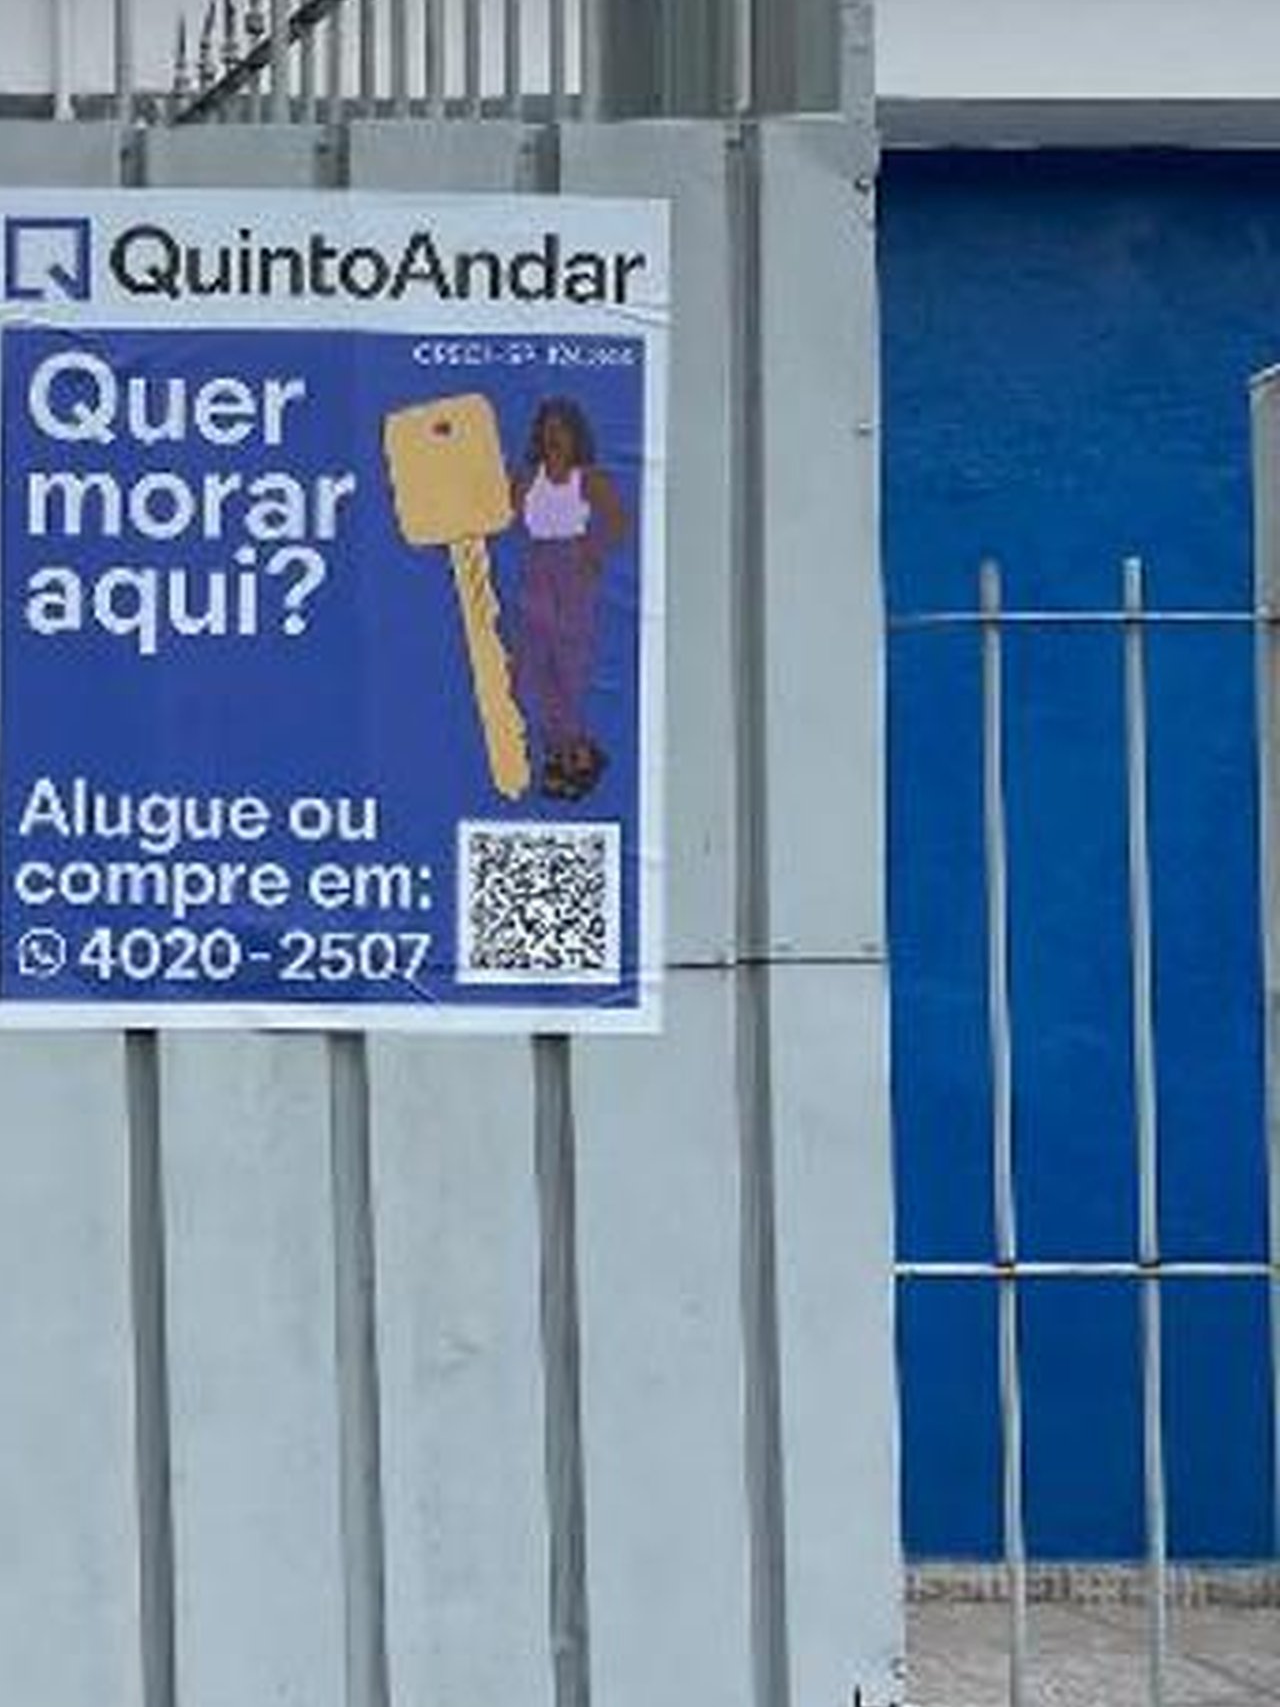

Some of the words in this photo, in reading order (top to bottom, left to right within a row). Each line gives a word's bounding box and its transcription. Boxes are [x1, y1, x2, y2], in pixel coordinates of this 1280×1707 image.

[109, 225, 646, 304] QuintoAndar
[29, 350, 306, 444] Quer
[28, 472, 356, 540] morar
[26, 546, 327, 654] aqui?
[19, 778, 271, 852] Alugue
[288, 796, 377, 842] ou
[14, 860, 290, 917] compre
[308, 862, 434, 910] em:
[78, 927, 433, 981] 4020-2507
